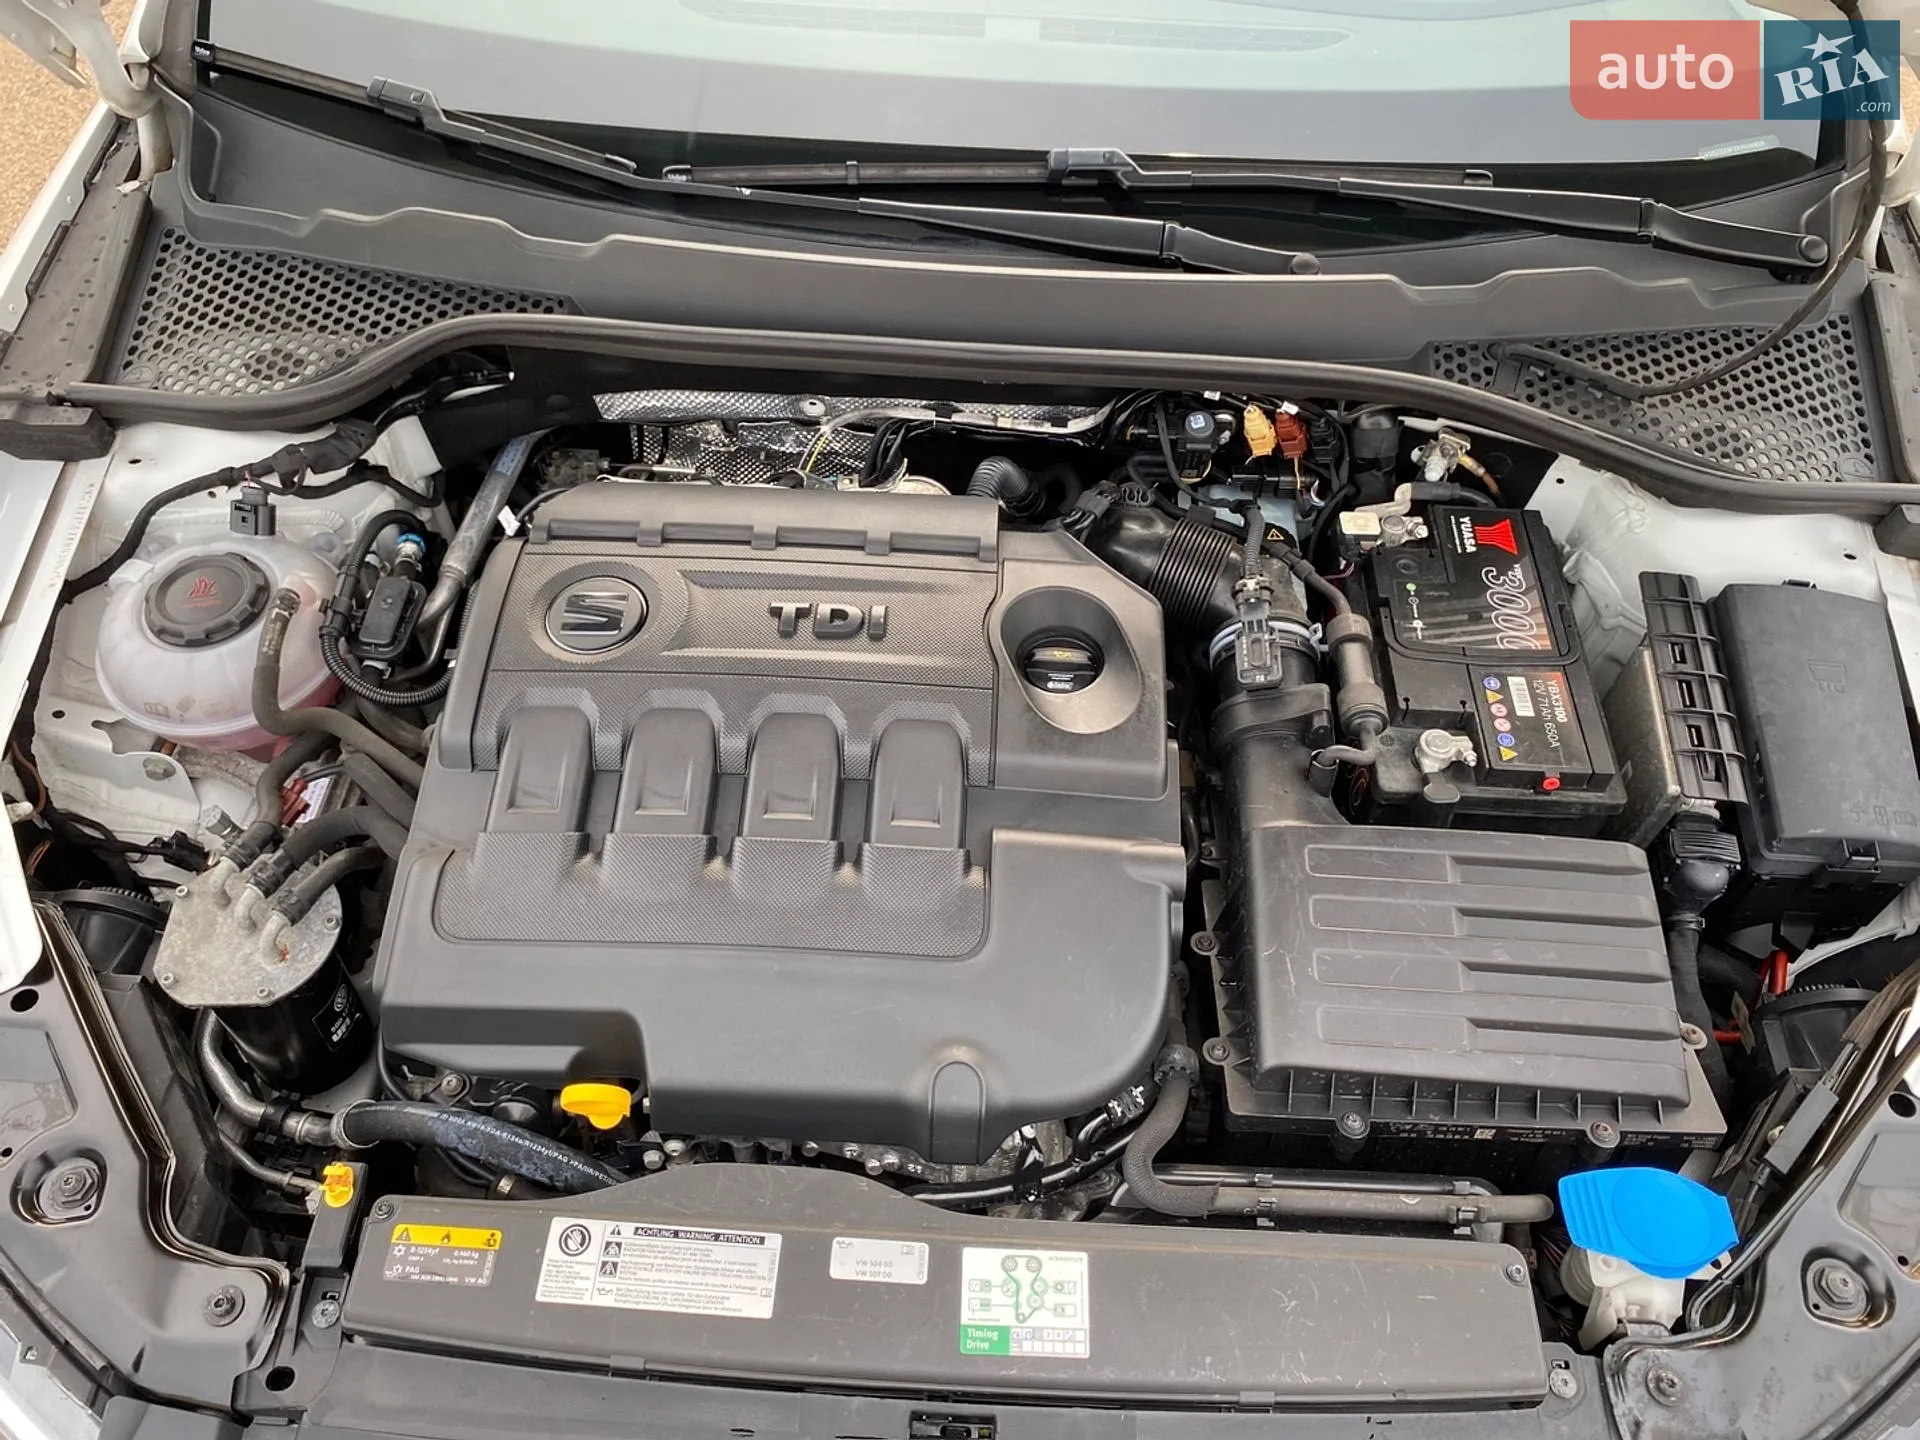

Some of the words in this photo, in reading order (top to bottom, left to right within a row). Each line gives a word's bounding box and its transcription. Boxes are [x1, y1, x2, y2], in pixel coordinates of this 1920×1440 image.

[1459, 516, 1477, 554] YUASA
[768, 602, 888, 640] TDI
[1532, 679, 1547, 695] 12V
[1543, 722, 1561, 748] 650A
[1546, 679, 1568, 723] YBX3100
[635, 1228, 675, 1238] ACHTUNG
[678, 1230, 715, 1241] WARNING
[718, 1234, 761, 1245] ATTENTION
[966, 1340, 990, 1351] Drive
[967, 1328, 999, 1342] Timing
